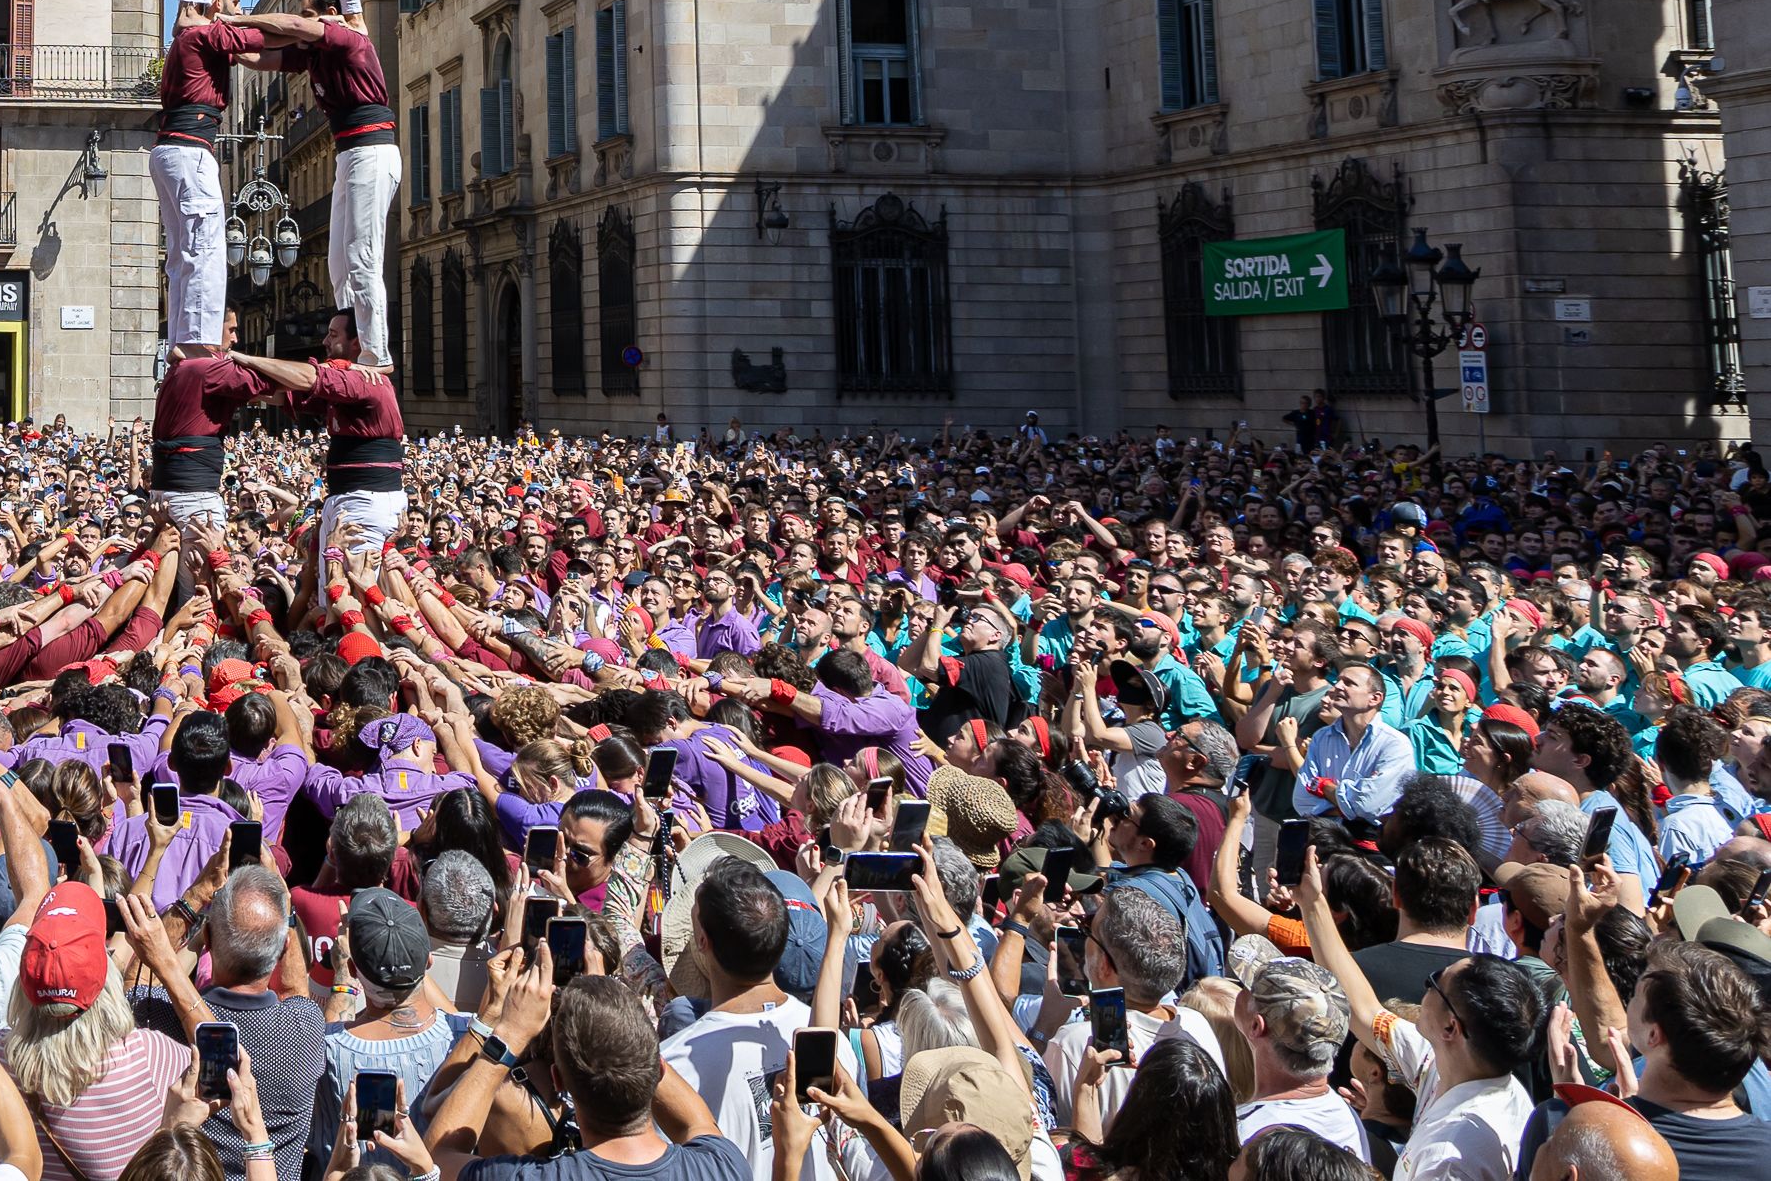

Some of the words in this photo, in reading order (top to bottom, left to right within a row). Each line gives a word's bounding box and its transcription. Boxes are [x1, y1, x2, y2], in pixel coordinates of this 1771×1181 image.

[1224, 254, 1291, 279] SORTIDA
[1214, 280, 1262, 300] SALIDA
[1274, 277, 1305, 298] EXIT
[37, 988, 77, 998] SAMURAI
